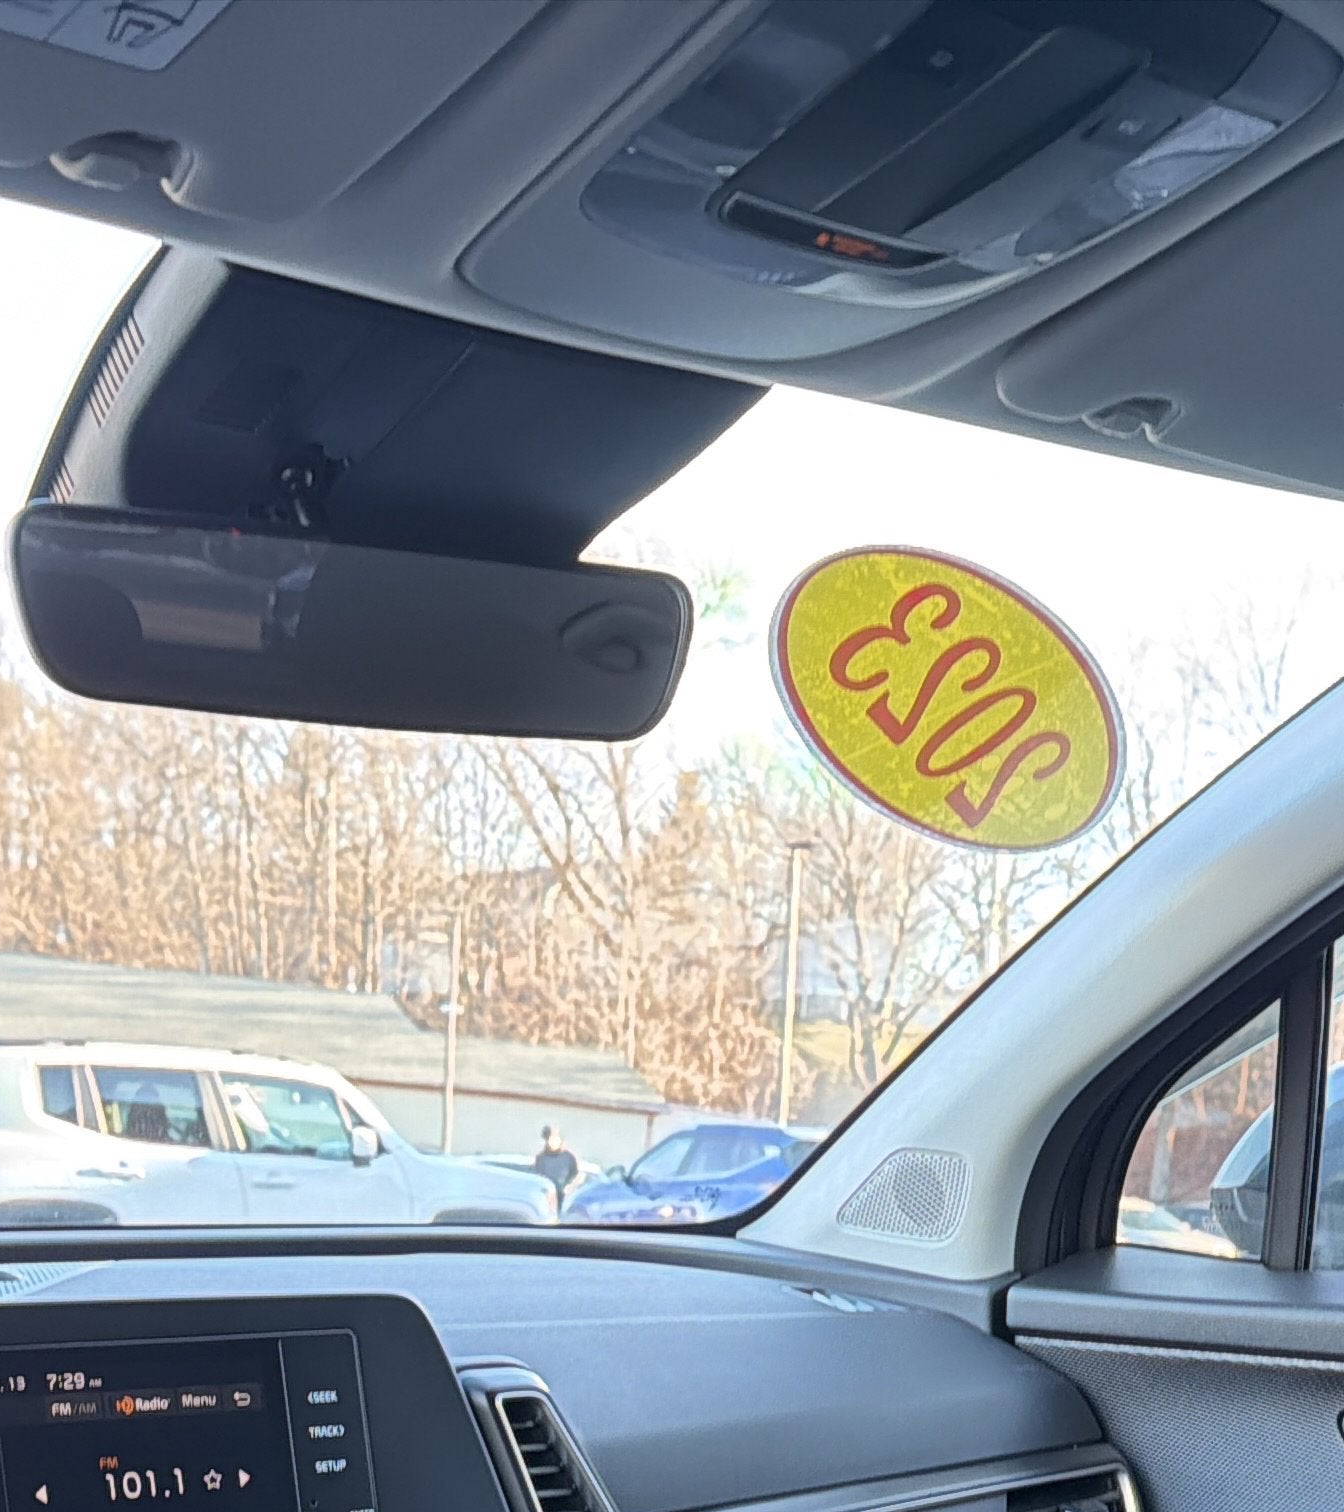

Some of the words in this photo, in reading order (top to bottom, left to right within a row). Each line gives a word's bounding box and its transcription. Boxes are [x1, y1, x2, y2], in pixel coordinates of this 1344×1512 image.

[45, 1371, 86, 1392] 7:29
[181, 1393, 217, 1409] Menu
[98, 1456, 119, 1470] FM
[105, 1466, 186, 1501] 101.1
